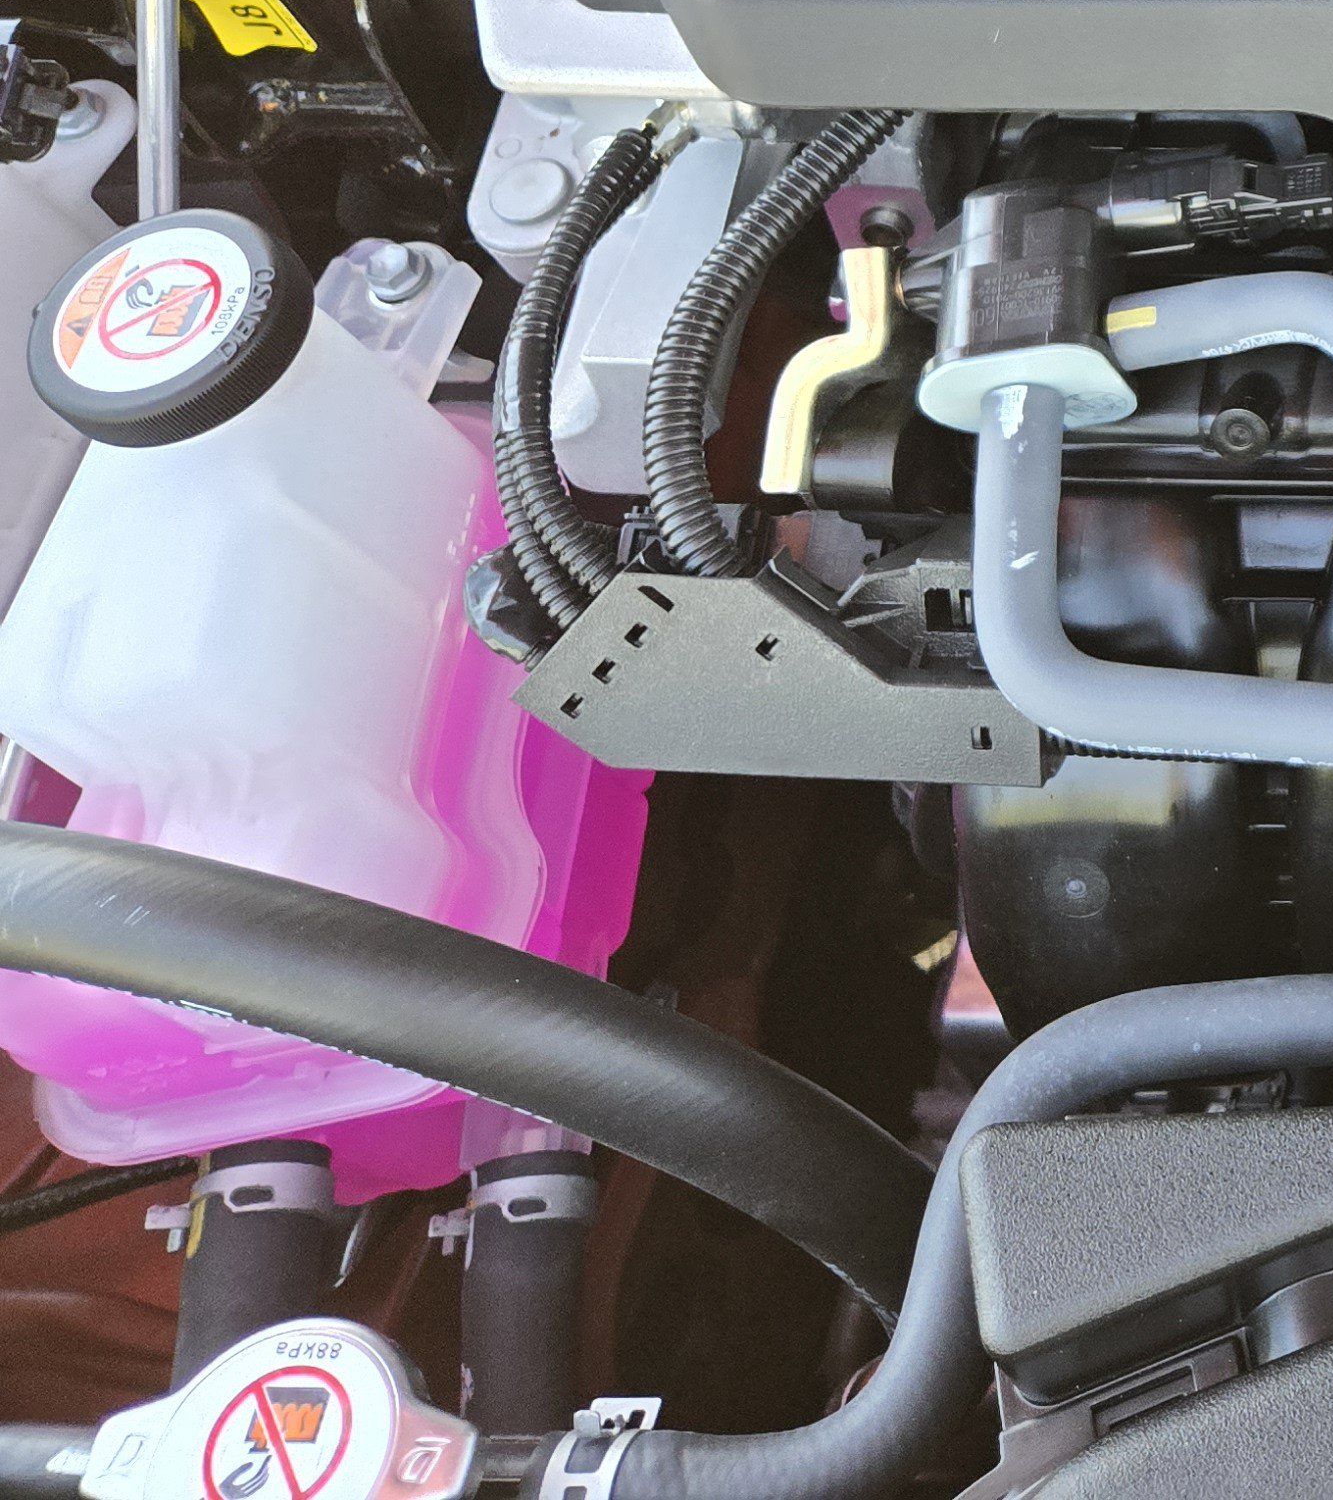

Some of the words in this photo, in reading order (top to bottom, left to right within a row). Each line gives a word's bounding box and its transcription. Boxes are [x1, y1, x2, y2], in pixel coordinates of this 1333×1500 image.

[211, 286, 246, 336] 108kPa
[218, 265, 276, 363] DENSO
[276, 1341, 342, 1359] 88kPa
